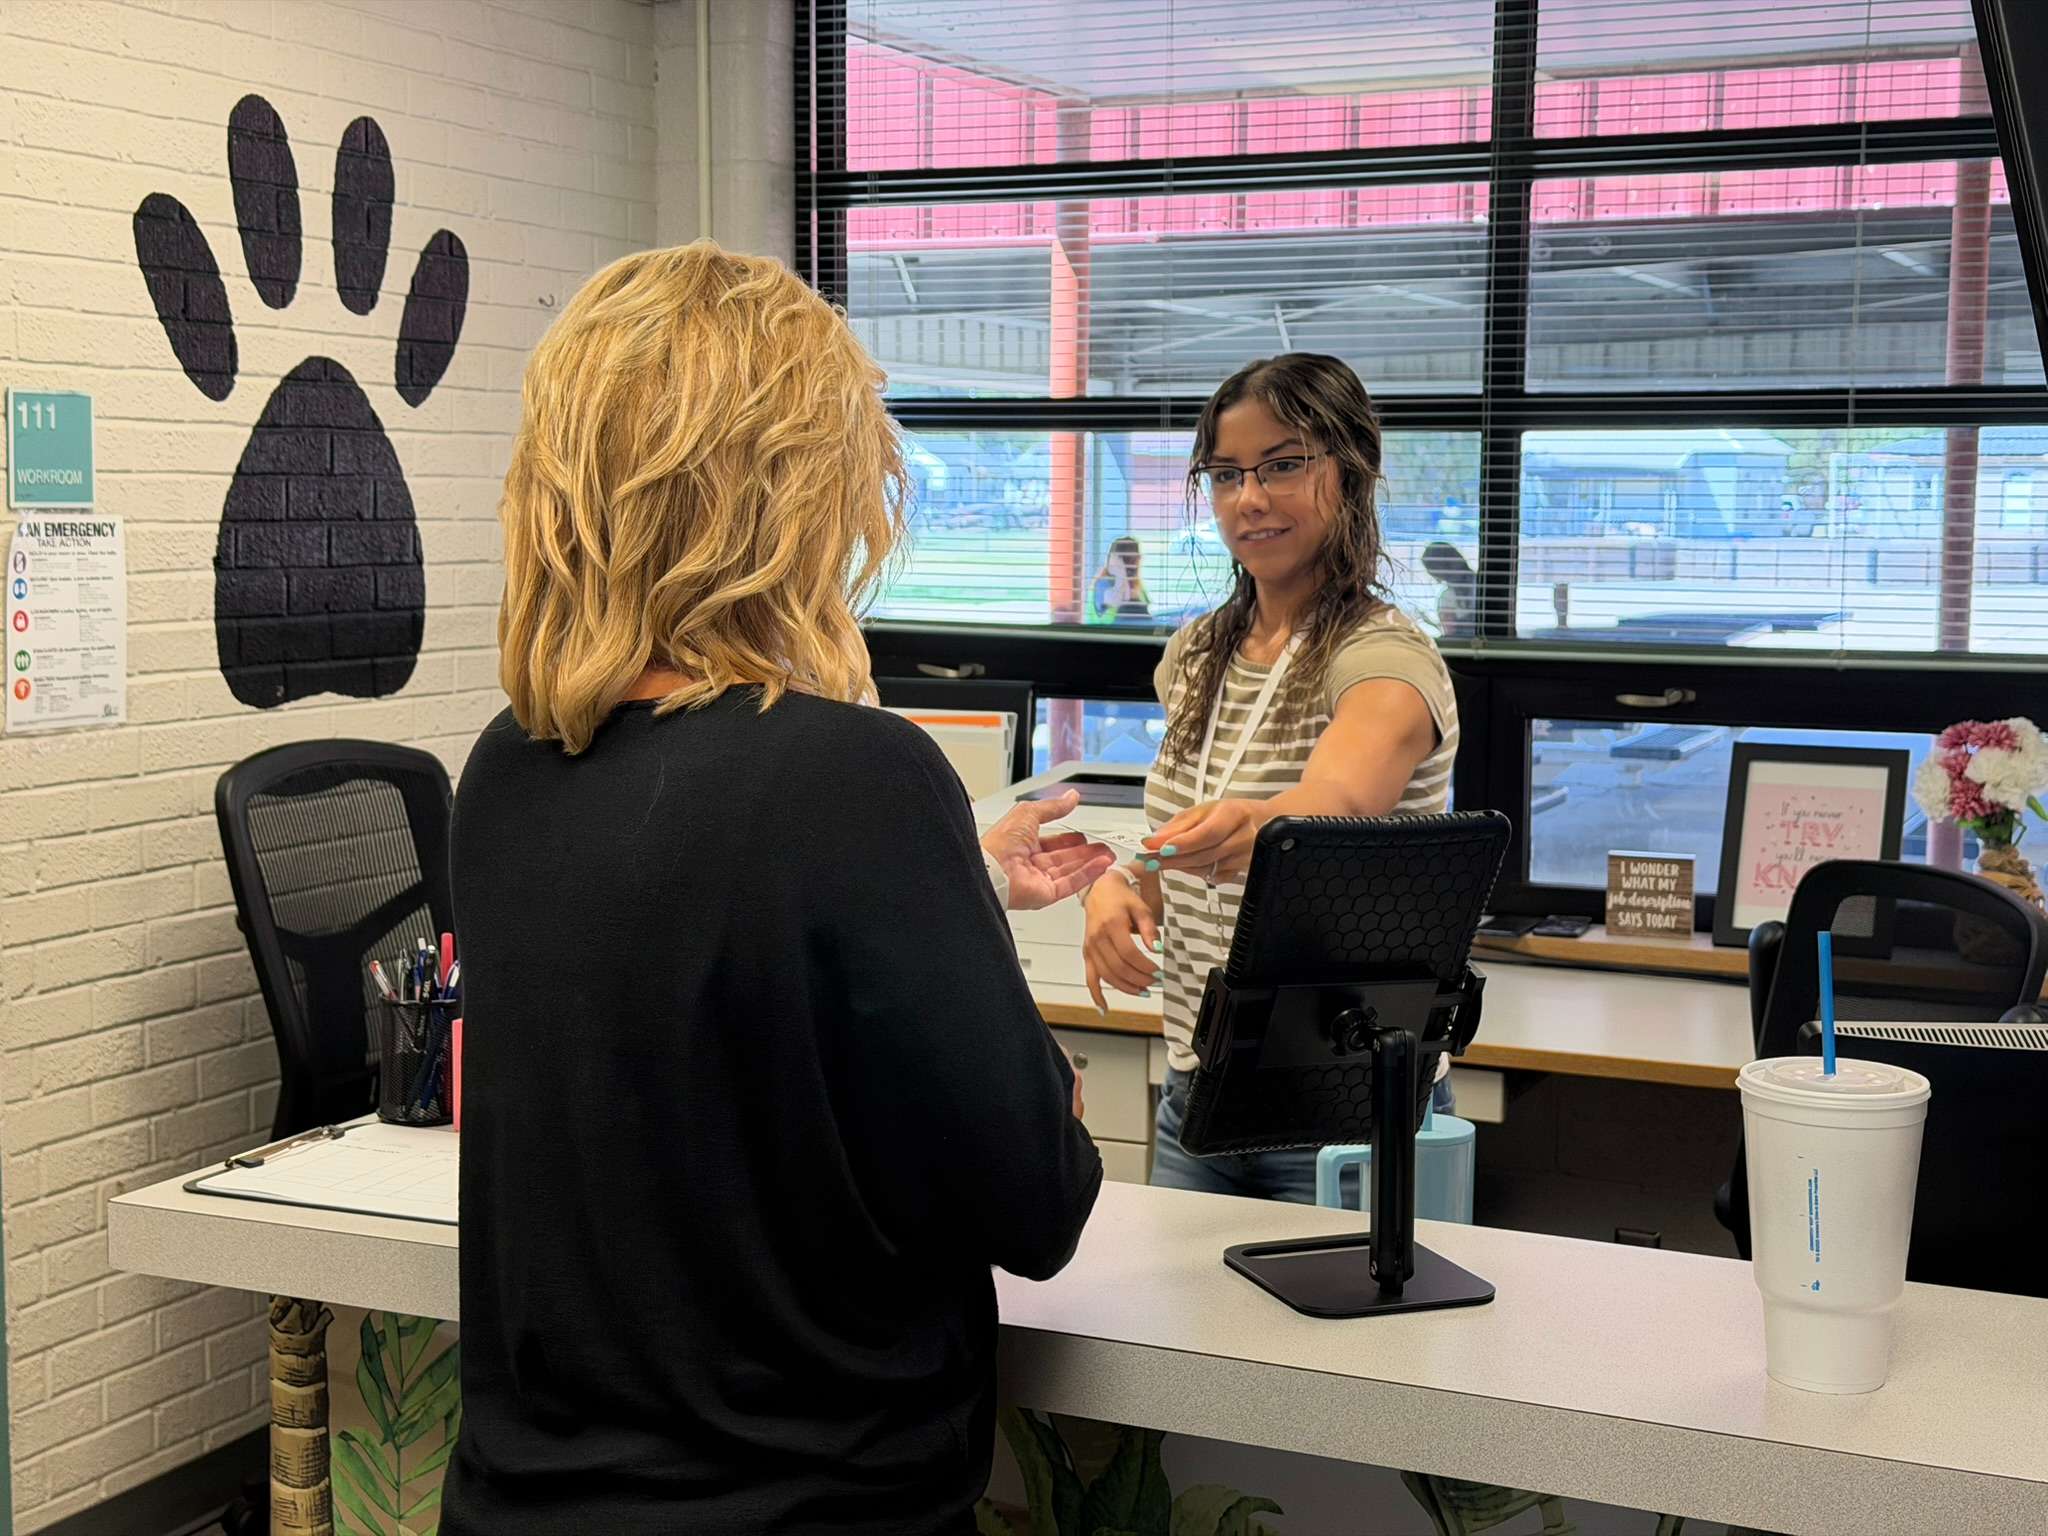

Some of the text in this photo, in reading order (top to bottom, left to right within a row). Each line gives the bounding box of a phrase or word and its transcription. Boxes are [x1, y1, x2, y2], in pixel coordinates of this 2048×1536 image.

[17, 401, 56, 430] 111
[16, 468, 83, 485] WORKROOM
[44, 522, 116, 537] EMERGENCY
[38, 539, 92, 547] TAKE ACTION
[1779, 820, 1844, 848] TRY
[1620, 860, 1680, 877] I WONDER
[1622, 876, 1677, 891] WHAT MY
[1607, 891, 1692, 912] job description
[1618, 911, 1677, 928] SAYS TODAY
